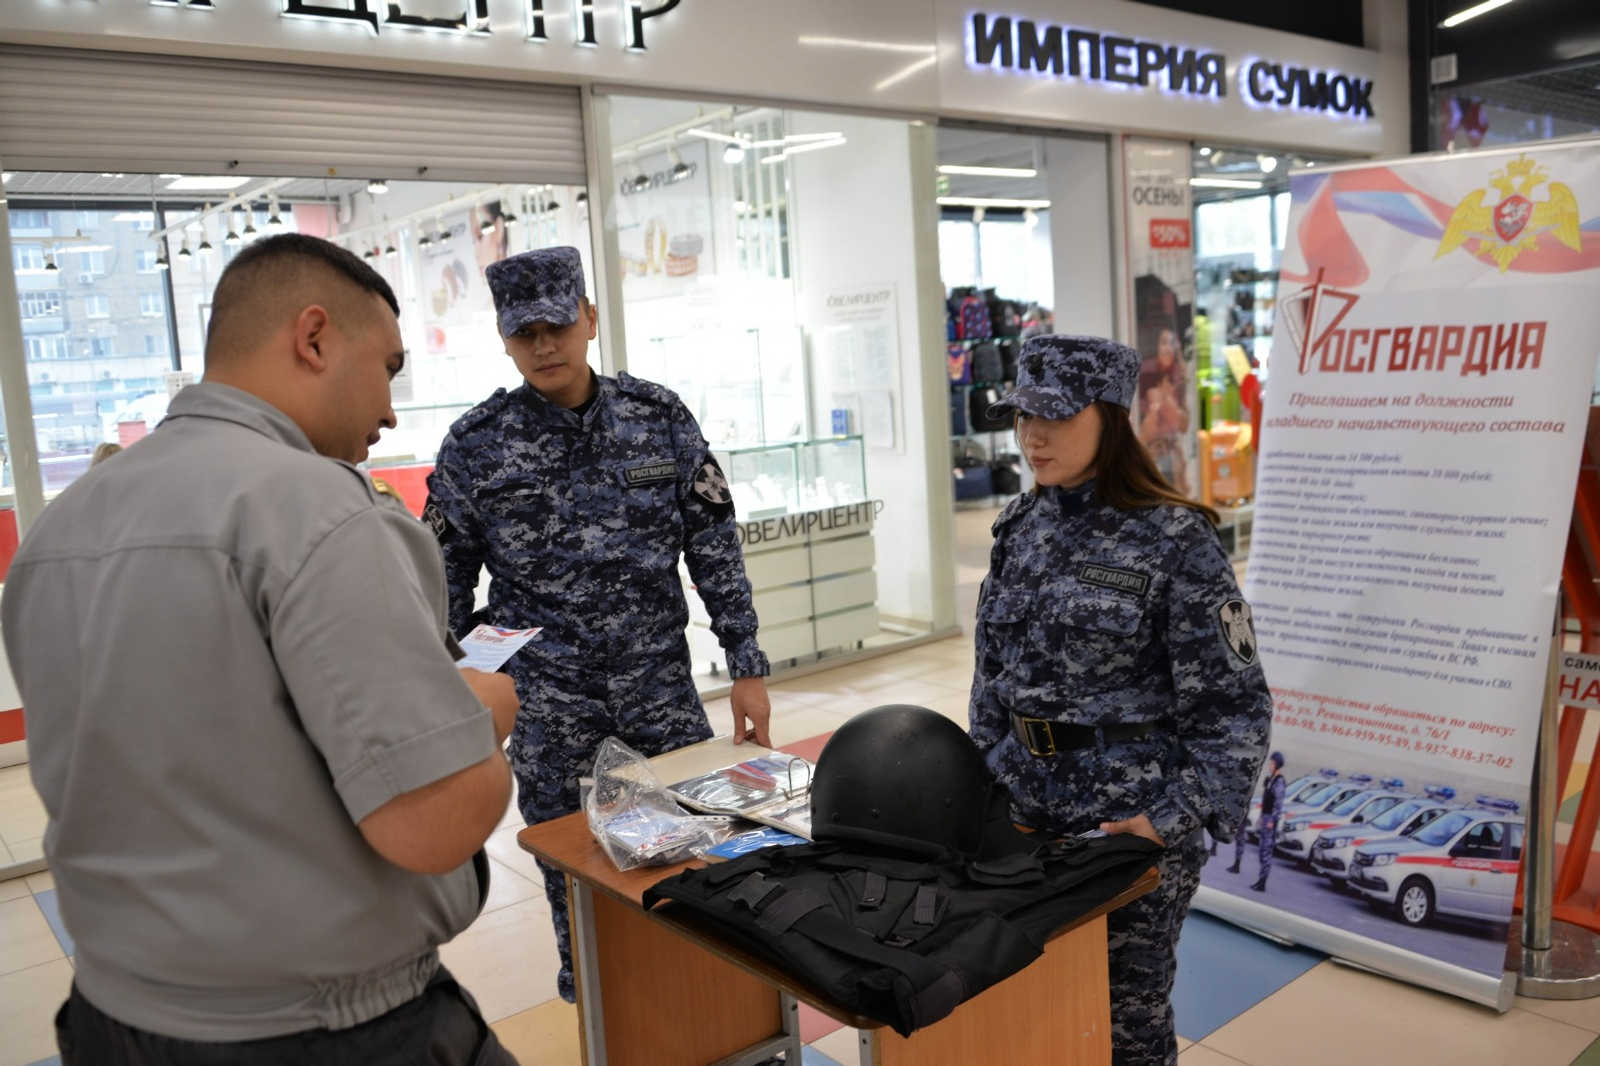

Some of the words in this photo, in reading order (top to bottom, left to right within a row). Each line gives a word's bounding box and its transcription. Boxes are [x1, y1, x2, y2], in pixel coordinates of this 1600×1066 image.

[972, 13, 1227, 98] ИМПЕРИЯ
[1248, 61, 1375, 118] СУМОК
[1281, 267, 1548, 377] РОСГВАРДИЯ
[1288, 392, 1388, 411] Приглашаем
[1391, 395, 1411, 408] на
[1414, 391, 1515, 409] должности
[1337, 416, 1486, 434] начальствующего
[1489, 418, 1566, 434] состава
[629, 464, 676, 479] РОСГВАРДИЯ
[1409, 509, 1506, 525] санаторно-курортное
[1508, 515, 1549, 527] лечение;
[1428, 550, 1481, 567] бесплатно;
[1084, 568, 1142, 590] РОСГВАРДИЯ
[1564, 656, 1600, 673] сам
[1316, 706, 1409, 735] Революционная,
[1425, 726, 1451, 741] 76/1
[1373, 703, 1447, 725] обращаться
[1449, 716, 1466, 728] по
[1468, 720, 1516, 738] адресу:
[1319, 722, 1411, 751] 8-964-959-95-89,
[1413, 739, 1514, 770] 8-937-838-37-02
